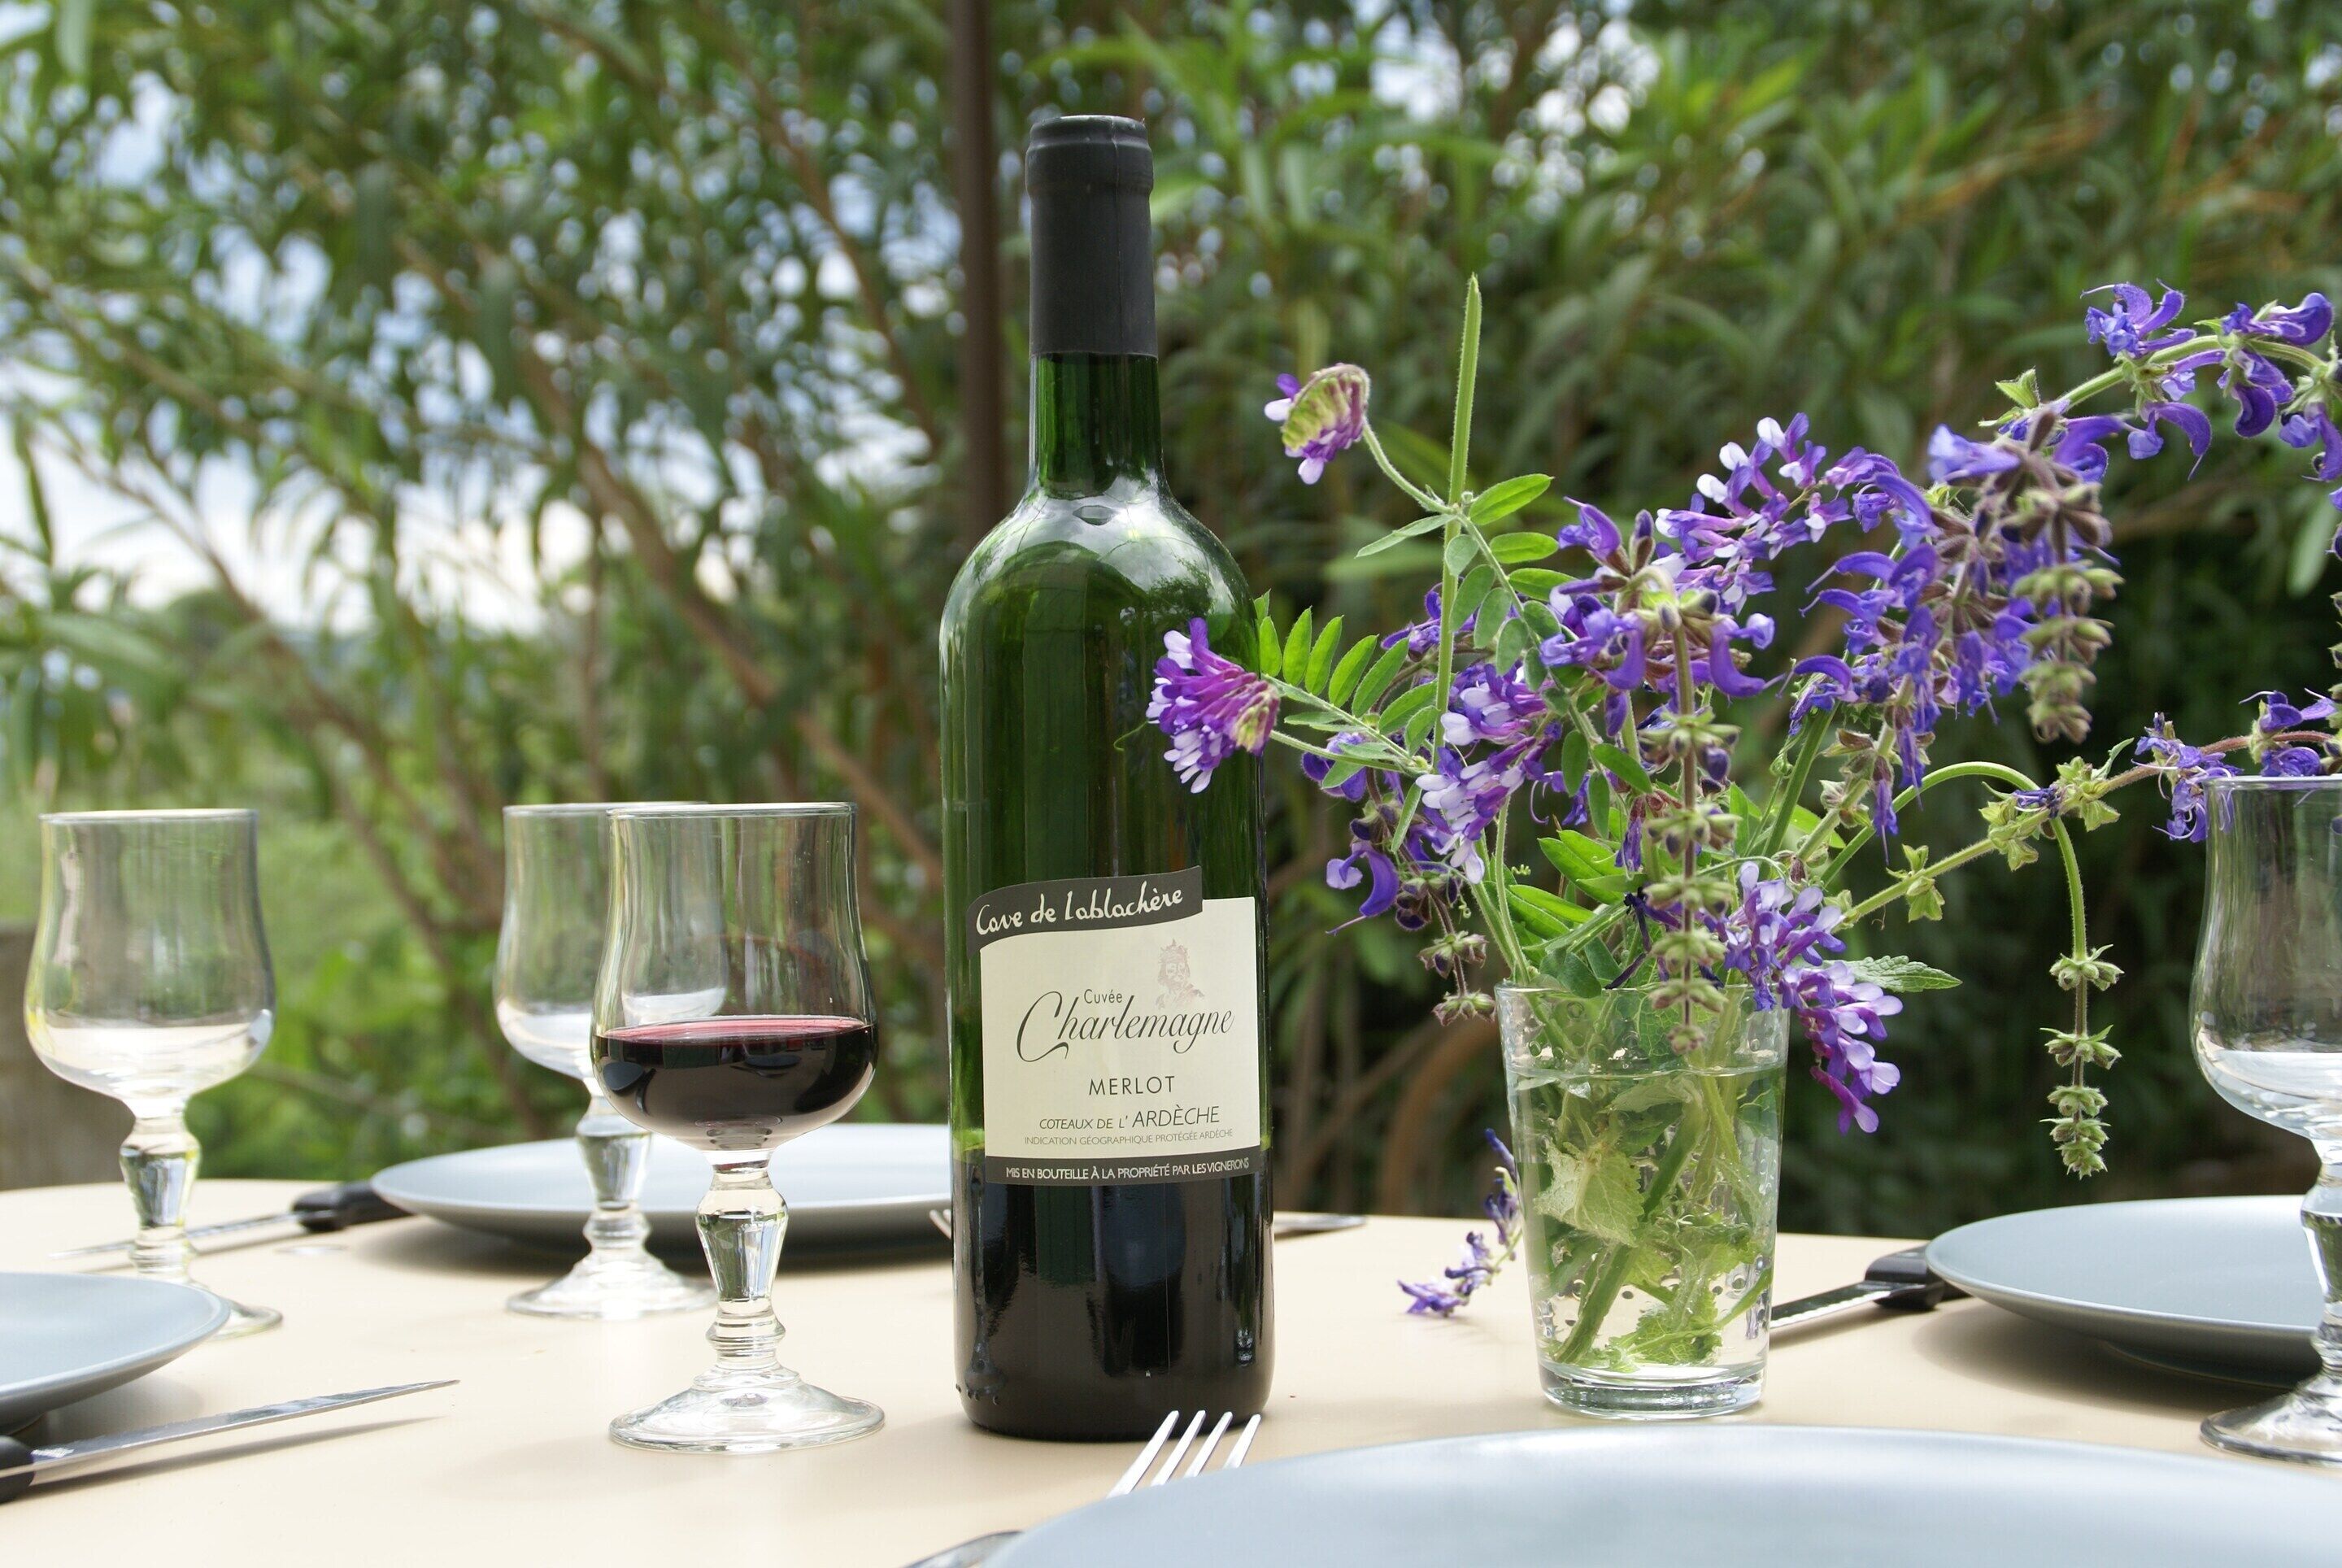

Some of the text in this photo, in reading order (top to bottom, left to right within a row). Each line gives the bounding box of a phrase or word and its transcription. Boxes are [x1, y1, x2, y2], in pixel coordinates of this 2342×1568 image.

[975, 904, 1023, 935] Cave
[1030, 892, 1057, 924] de
[1083, 988, 1123, 1005] Cuvée
[1016, 991, 1235, 1063] Charlemagne
[1088, 1075, 1176, 1096] MERLOT
[1038, 1118, 1095, 1130] COTEAUX
[1096, 1117, 1113, 1130] DE
[1131, 1104, 1221, 1128] ARDÈCHE
[1024, 1136, 1077, 1146] INDICATION
[1078, 1134, 1154, 1146] GÉOGRAPHIQUE
[1155, 1130, 1198, 1143] PROTÉGÉE
[1005, 1156, 1250, 1180] MIS EN BOUTEILLE À LA PROPRIÉTÉ PAR LES VIGNERONS
